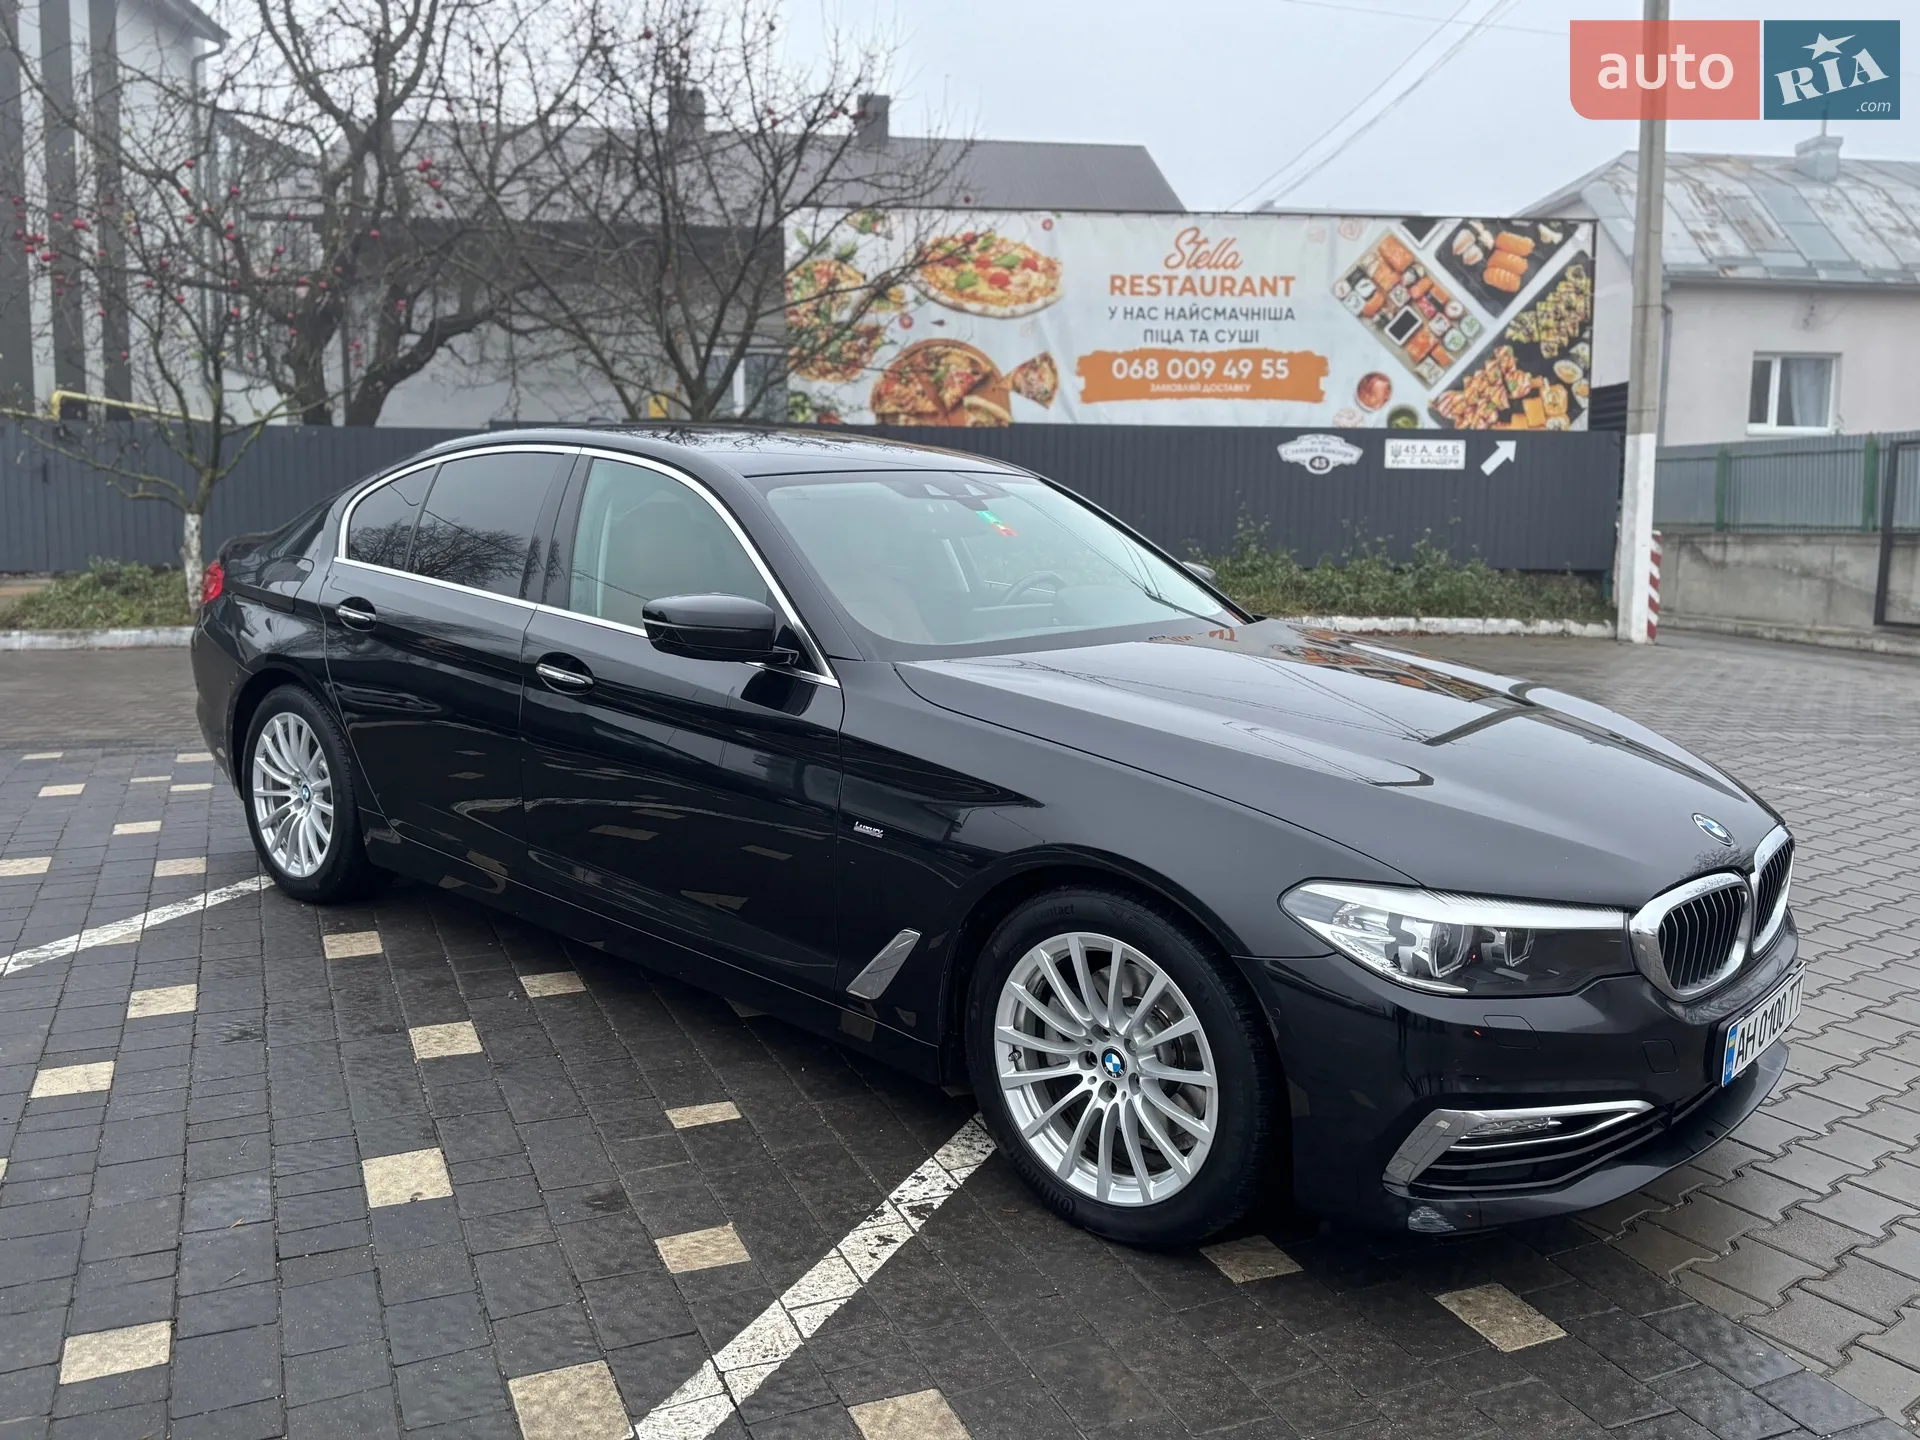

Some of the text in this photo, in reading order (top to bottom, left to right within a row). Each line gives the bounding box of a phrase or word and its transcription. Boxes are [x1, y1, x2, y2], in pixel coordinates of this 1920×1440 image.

[1164, 226, 1243, 270] Stella
[1109, 275, 1296, 297] RESTAURANT
[1108, 303, 1296, 321] У НАС НАЙСМАЧНІША
[1143, 328, 1260, 346] ПІЦА ТА СУШІ
[1111, 358, 1290, 380] 068 009 49 55
[1403, 444, 1418, 454] 45
[1311, 457, 1328, 469] 45
[1757, 991, 1787, 1048] 0100
